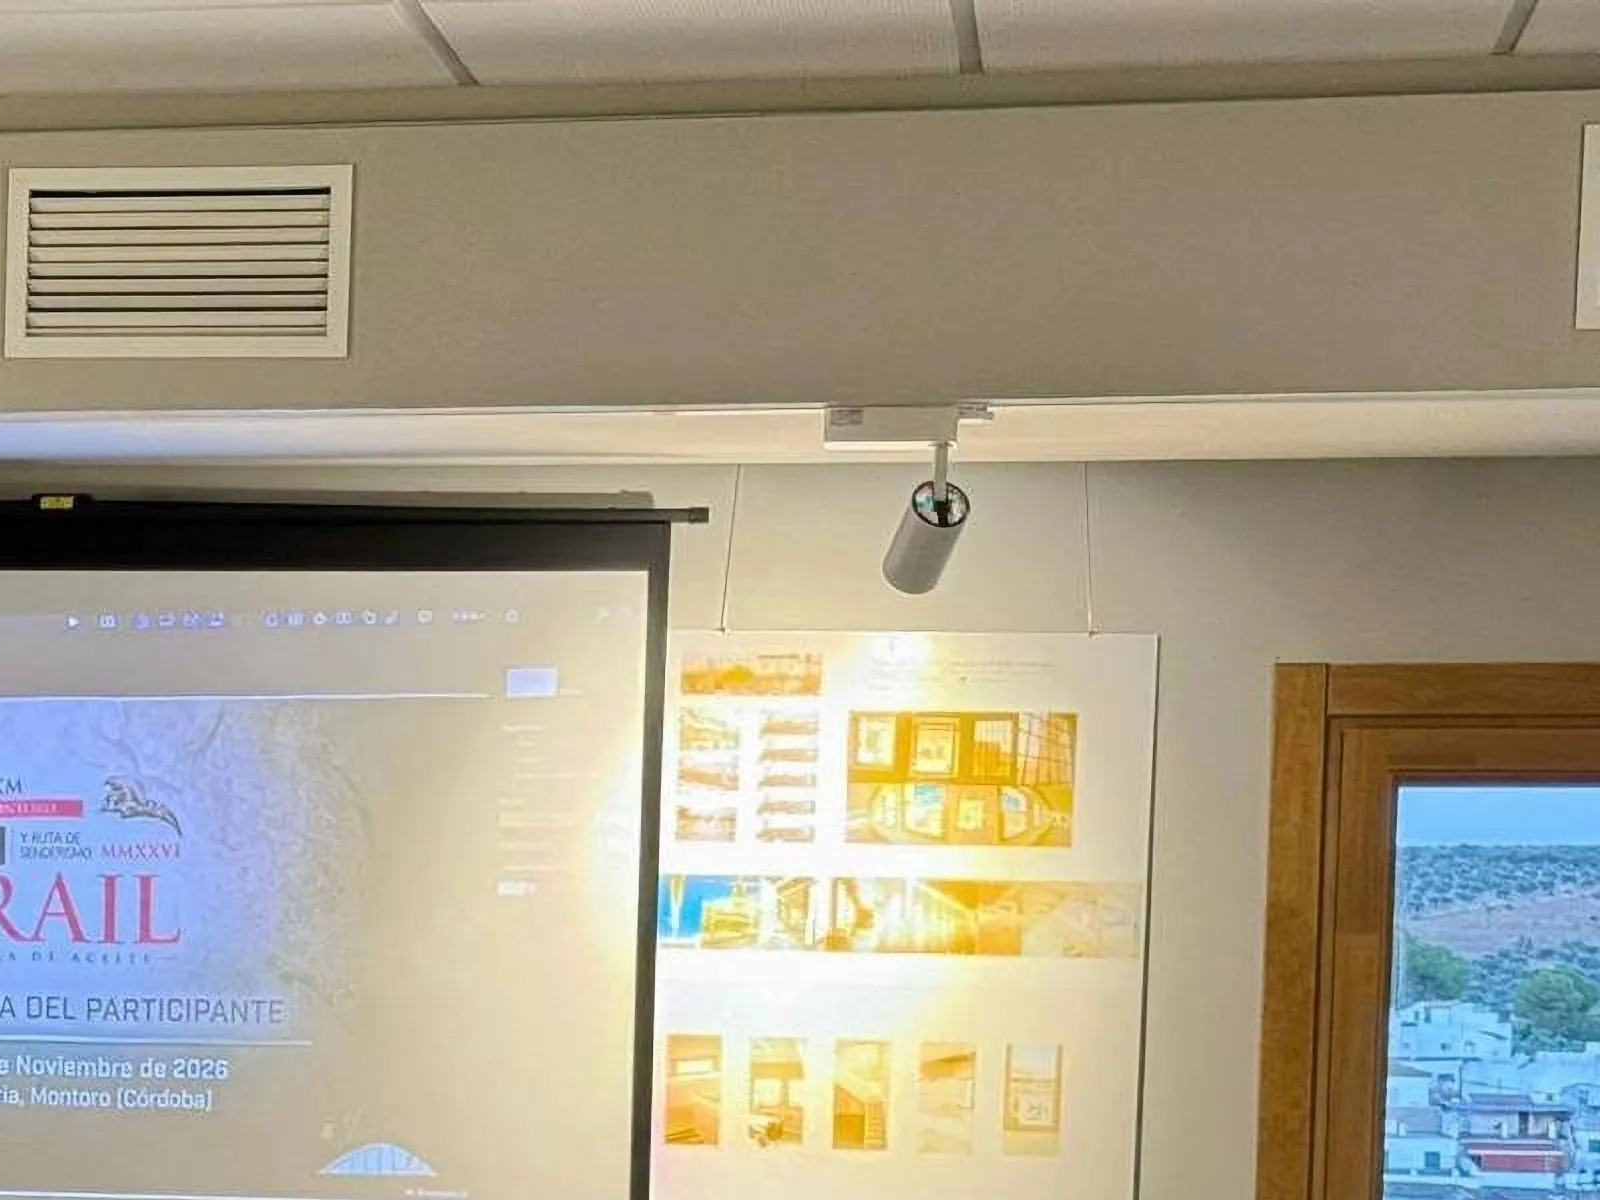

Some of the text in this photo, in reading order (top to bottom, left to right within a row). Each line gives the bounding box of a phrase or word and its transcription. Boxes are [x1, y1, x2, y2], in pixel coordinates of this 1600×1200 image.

[101, 844, 181, 860] MMXXVI
[27, 996, 77, 1020] DEL
[87, 996, 282, 1023] PARTICIPANTE
[16, 1055, 134, 1079] Noviembre
[140, 1057, 166, 1079] de
[173, 1058, 229, 1080] 2026
[31, 1087, 112, 1107] Montoro
